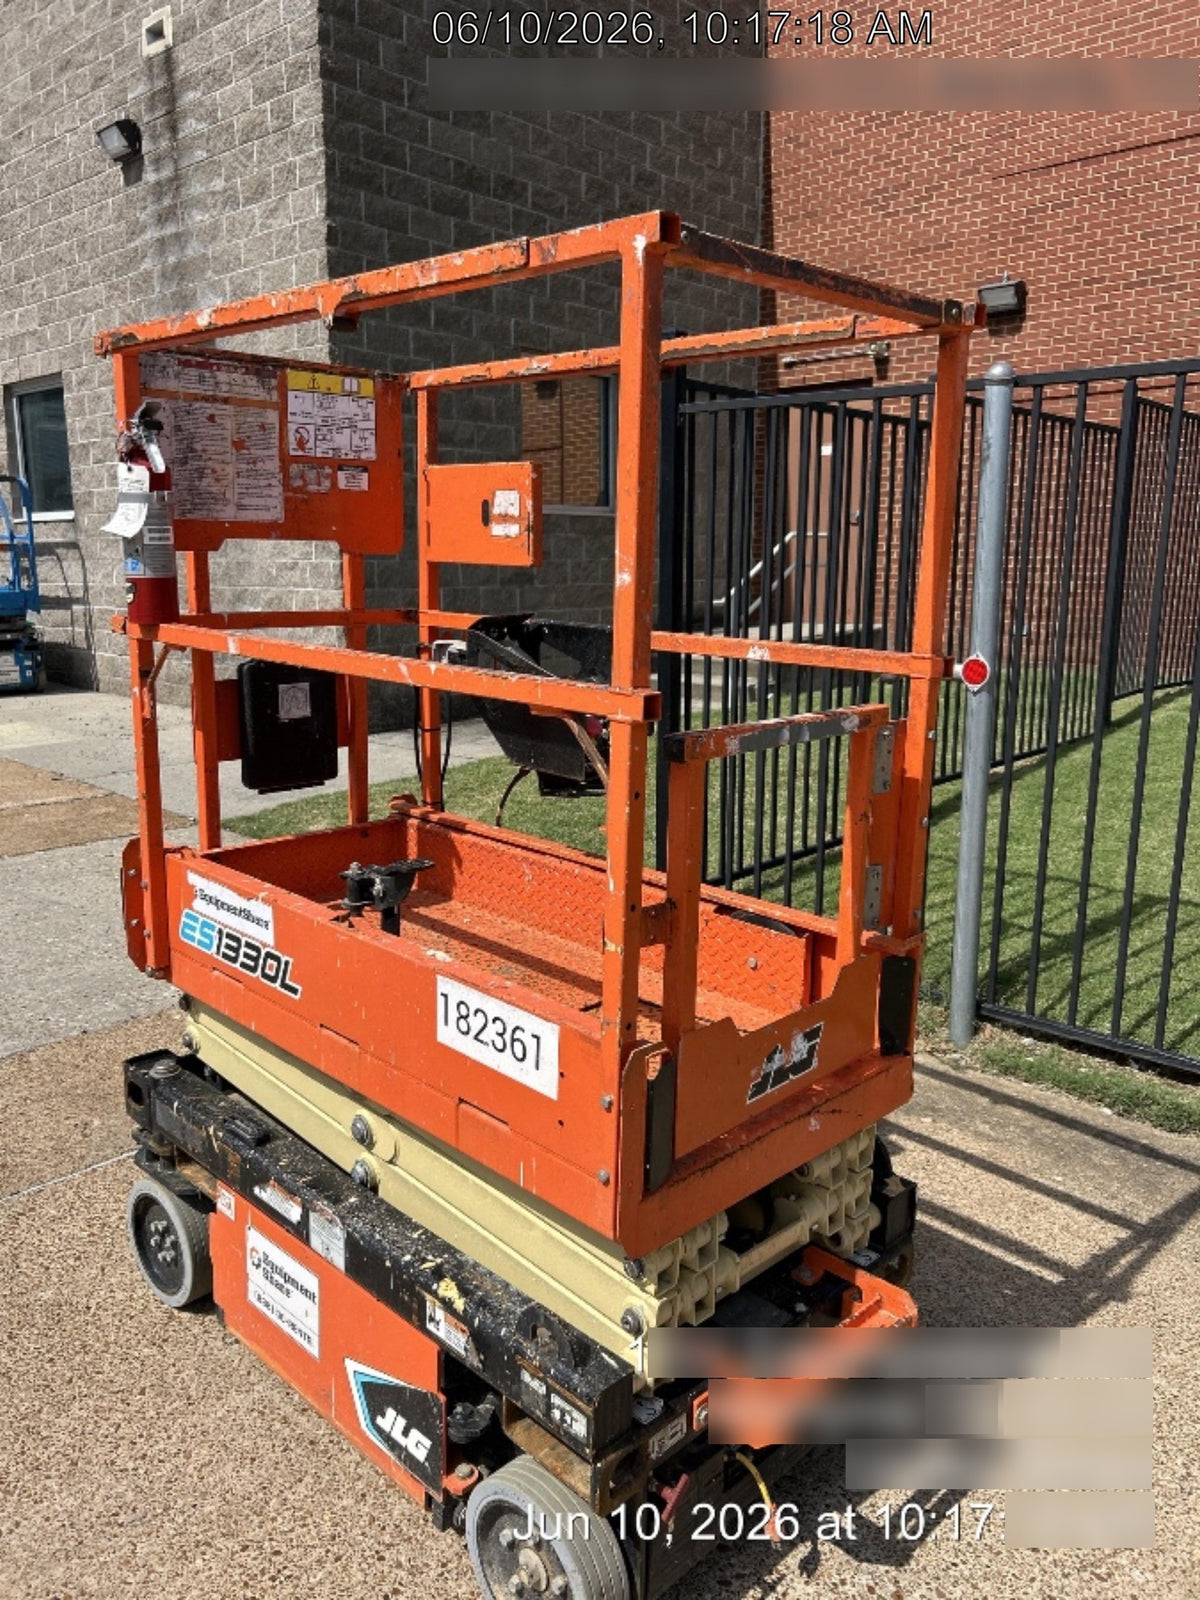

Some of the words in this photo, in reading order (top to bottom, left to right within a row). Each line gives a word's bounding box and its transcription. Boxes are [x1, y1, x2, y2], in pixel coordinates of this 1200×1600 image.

[180, 910, 300, 998] ES1330L
[439, 991, 541, 1071] 182361
[262, 1250, 318, 1306] Equipment
[375, 1407, 432, 1464] JLG
